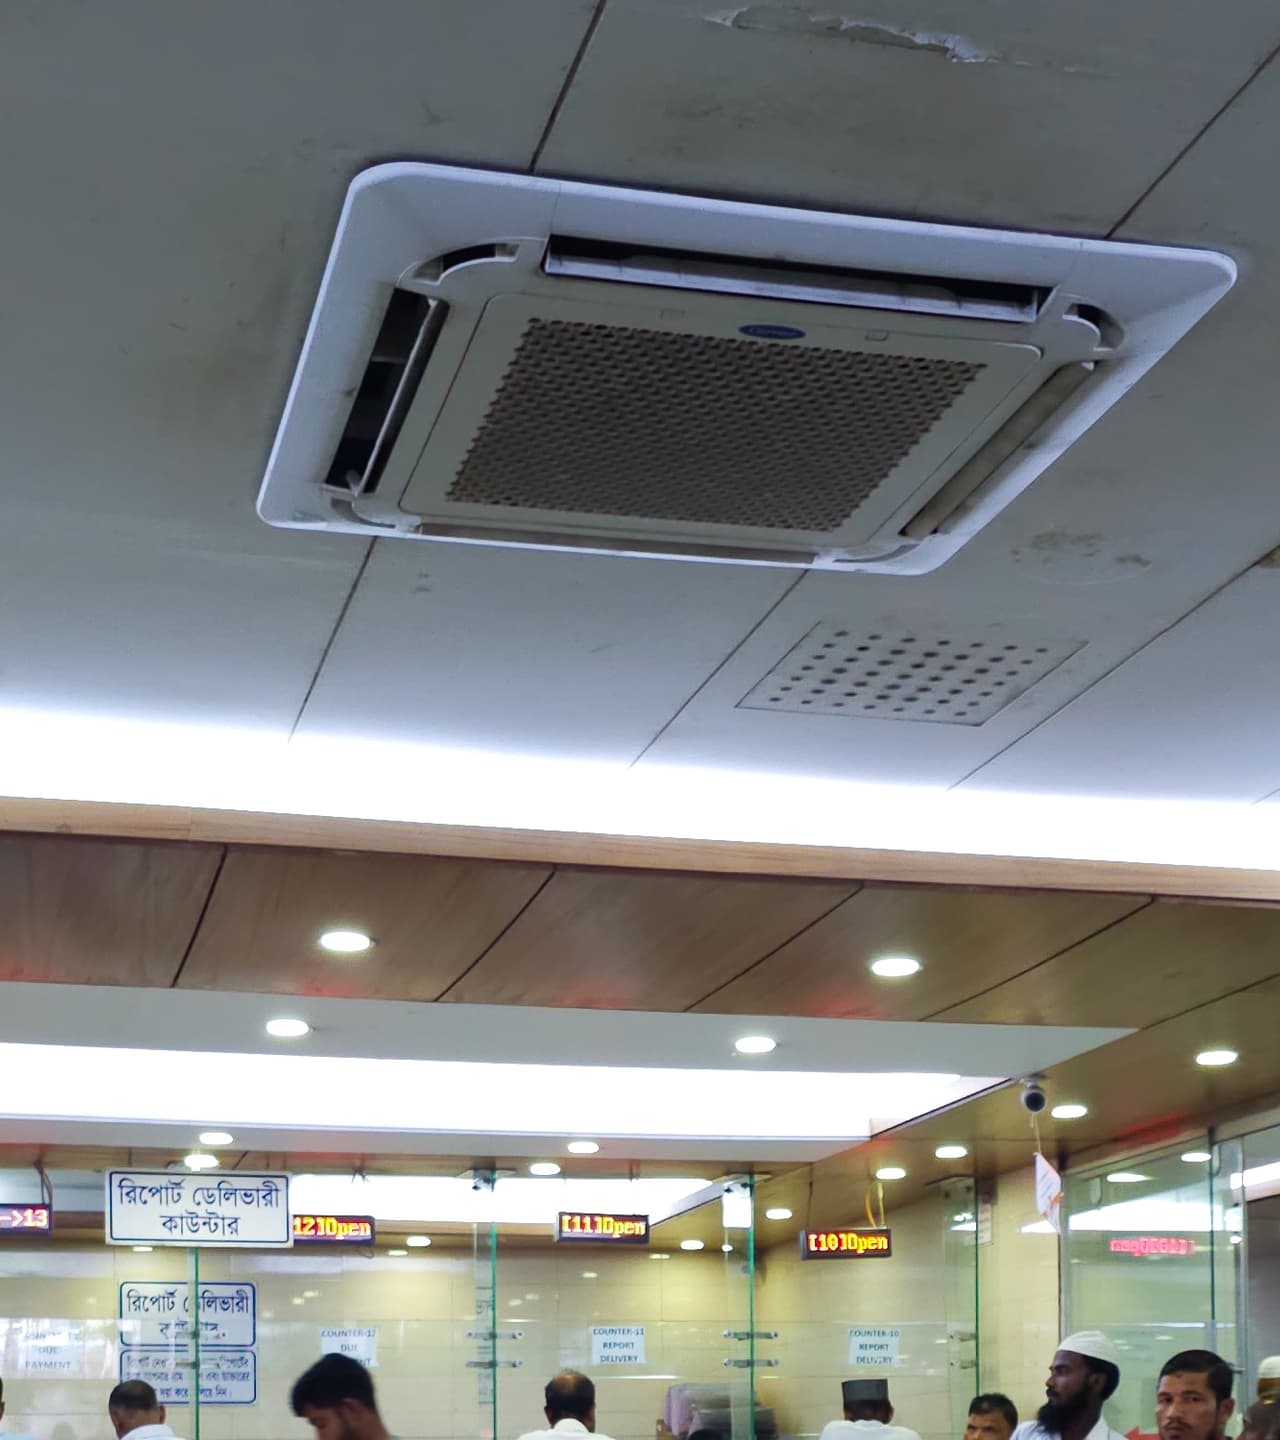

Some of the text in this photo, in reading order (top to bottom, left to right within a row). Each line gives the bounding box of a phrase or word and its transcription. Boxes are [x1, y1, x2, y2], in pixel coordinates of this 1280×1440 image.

[118, 1178, 281, 1208] রিপোর্ট ডেলিভারী
[160, 1209, 240, 1236] কাউন্টার
[126, 1289, 249, 1313] রিপোর্ট েলিভারী
[593, 1327, 644, 1336] COUNTER-11
[340, 1343, 359, 1352] DUE
[603, 1341, 634, 1350] REPORT
[859, 1343, 888, 1352] REPORT
[600, 1355, 638, 1363] DELIVERY
[856, 1356, 892, 1365] DELIVERY
[25, 1360, 71, 1369] PAYMENT
